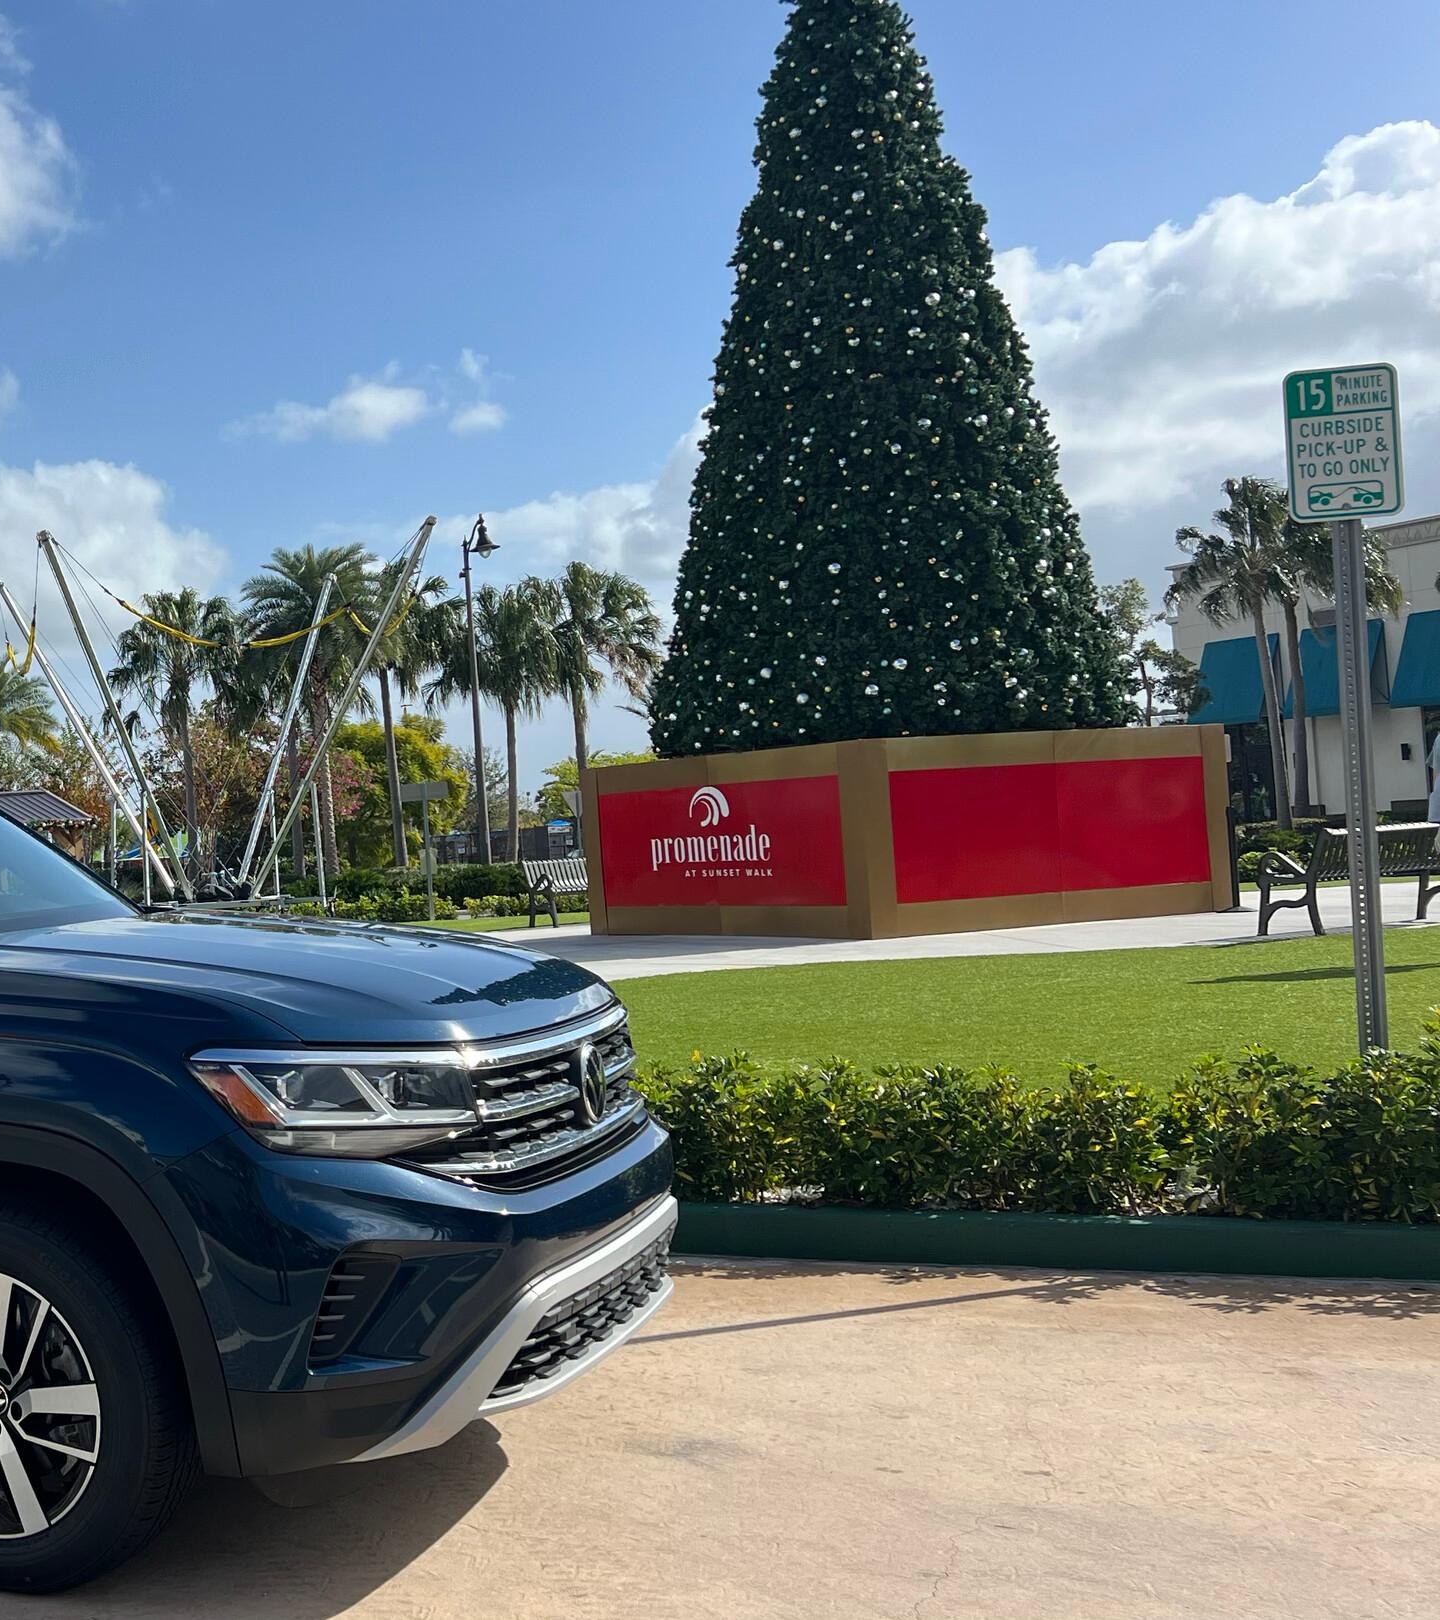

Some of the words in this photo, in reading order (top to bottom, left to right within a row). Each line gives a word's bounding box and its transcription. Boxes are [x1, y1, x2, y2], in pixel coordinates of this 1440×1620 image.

[1338, 375, 1384, 390] MINUTE
[1296, 378, 1326, 411] 15
[1336, 390, 1388, 407] PARKING
[1300, 416, 1385, 438] CURBSIDE
[1297, 438, 1366, 458] PICK-UP
[1375, 437, 1390, 452] &
[1298, 463, 1317, 479] TO
[1323, 461, 1343, 477] GO
[1349, 457, 1390, 475] ONLY
[650, 824, 771, 872] promenade
[685, 869, 697, 878] AT
[702, 868, 741, 878] SUNSET
[745, 868, 774, 877] WALK
